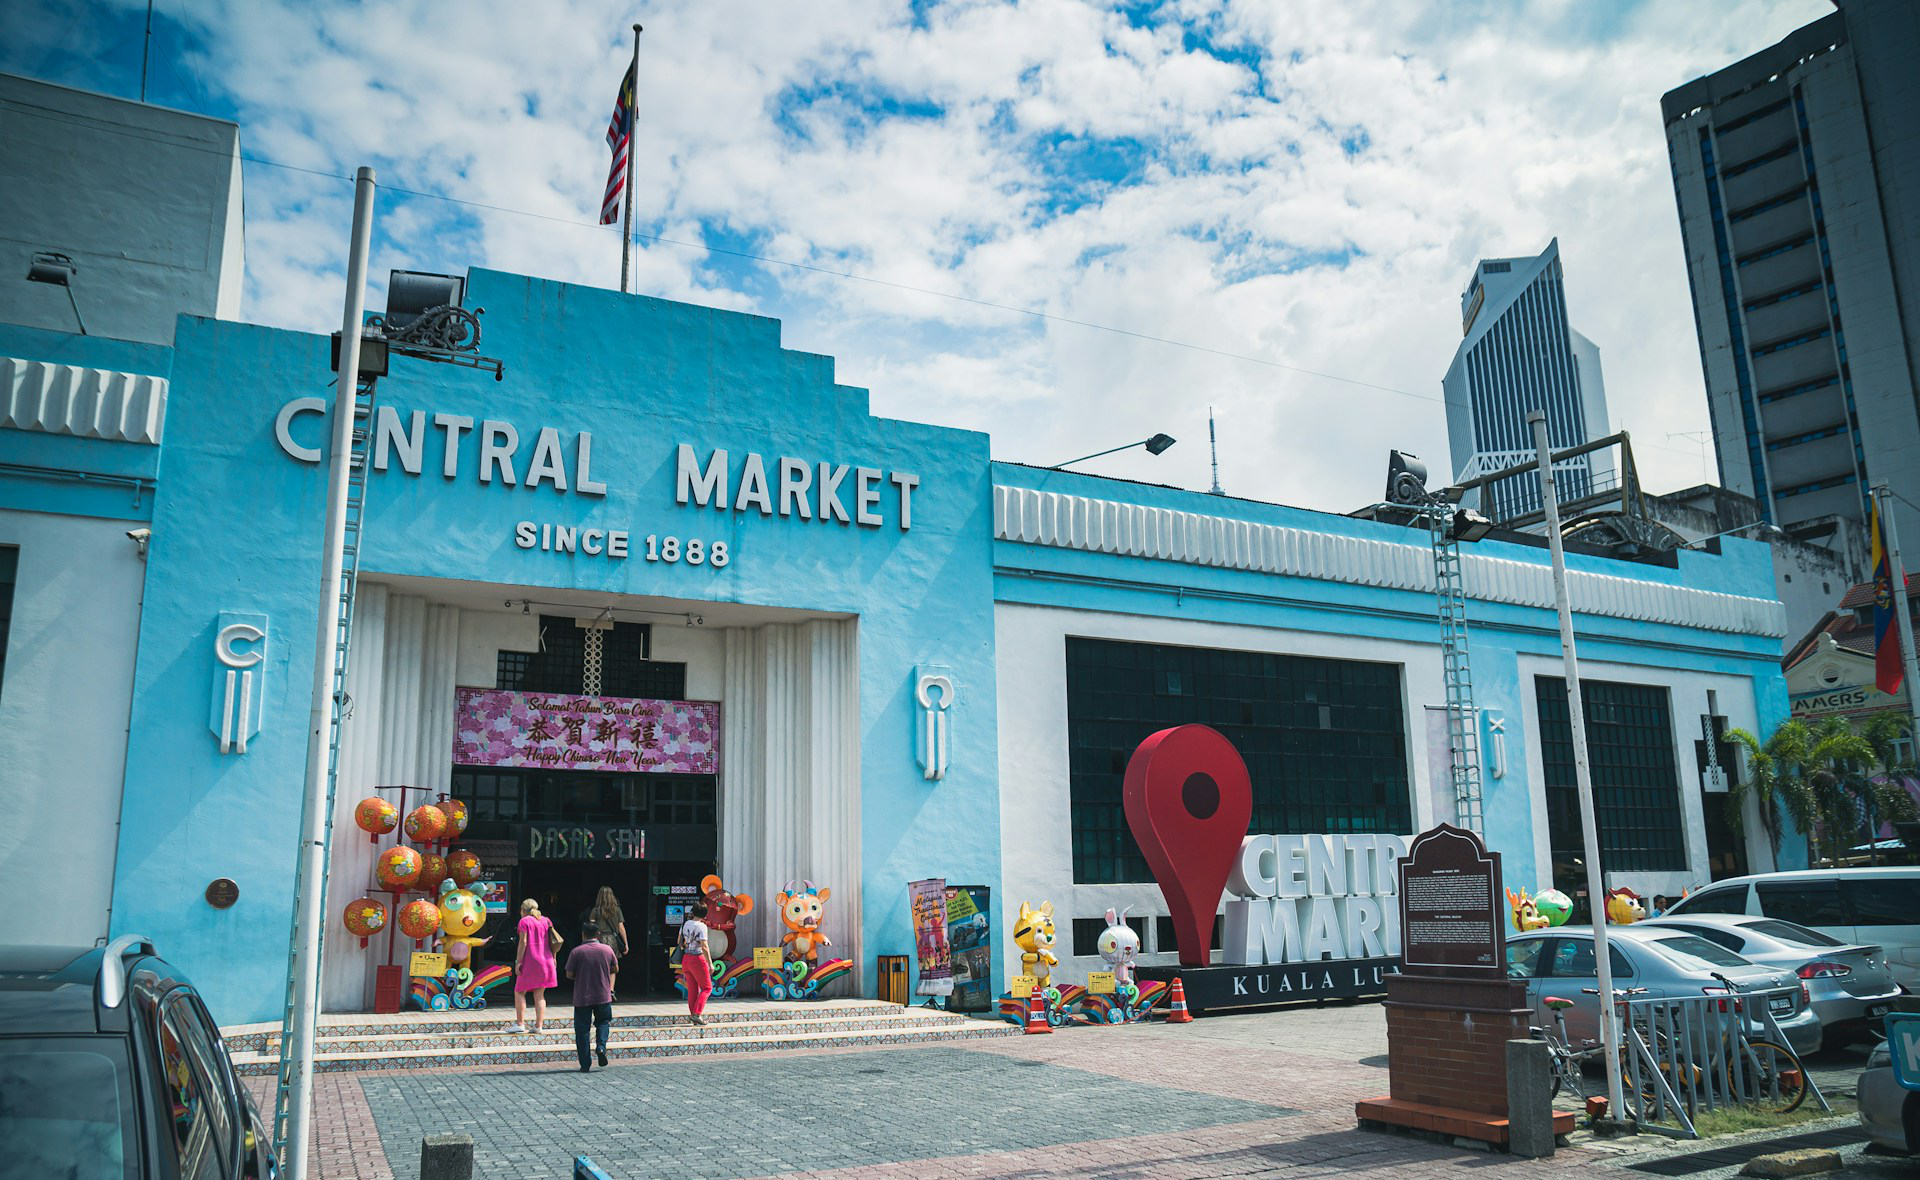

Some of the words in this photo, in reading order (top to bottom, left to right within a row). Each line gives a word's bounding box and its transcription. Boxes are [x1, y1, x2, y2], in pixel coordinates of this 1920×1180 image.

[675, 443, 920, 530] MARKET
[515, 521, 629, 558] SINCE
[646, 534, 730, 568] 1888
[528, 697, 571, 712] Selamat
[573, 699, 602, 714] Tahun
[603, 701, 631, 715] Baru
[631, 703, 655, 717] Cina
[525, 715, 659, 749] 恭賀新禧
[524, 747, 561, 765] Happy
[562, 749, 600, 763] Chinese
[602, 750, 628, 765] New
[630, 751, 657, 770] Year
[531, 827, 595, 859] PASAR
[605, 828, 645, 859] SENI
[1240, 833, 1407, 897] CENTR
[1233, 970, 1335, 996] KUALA
